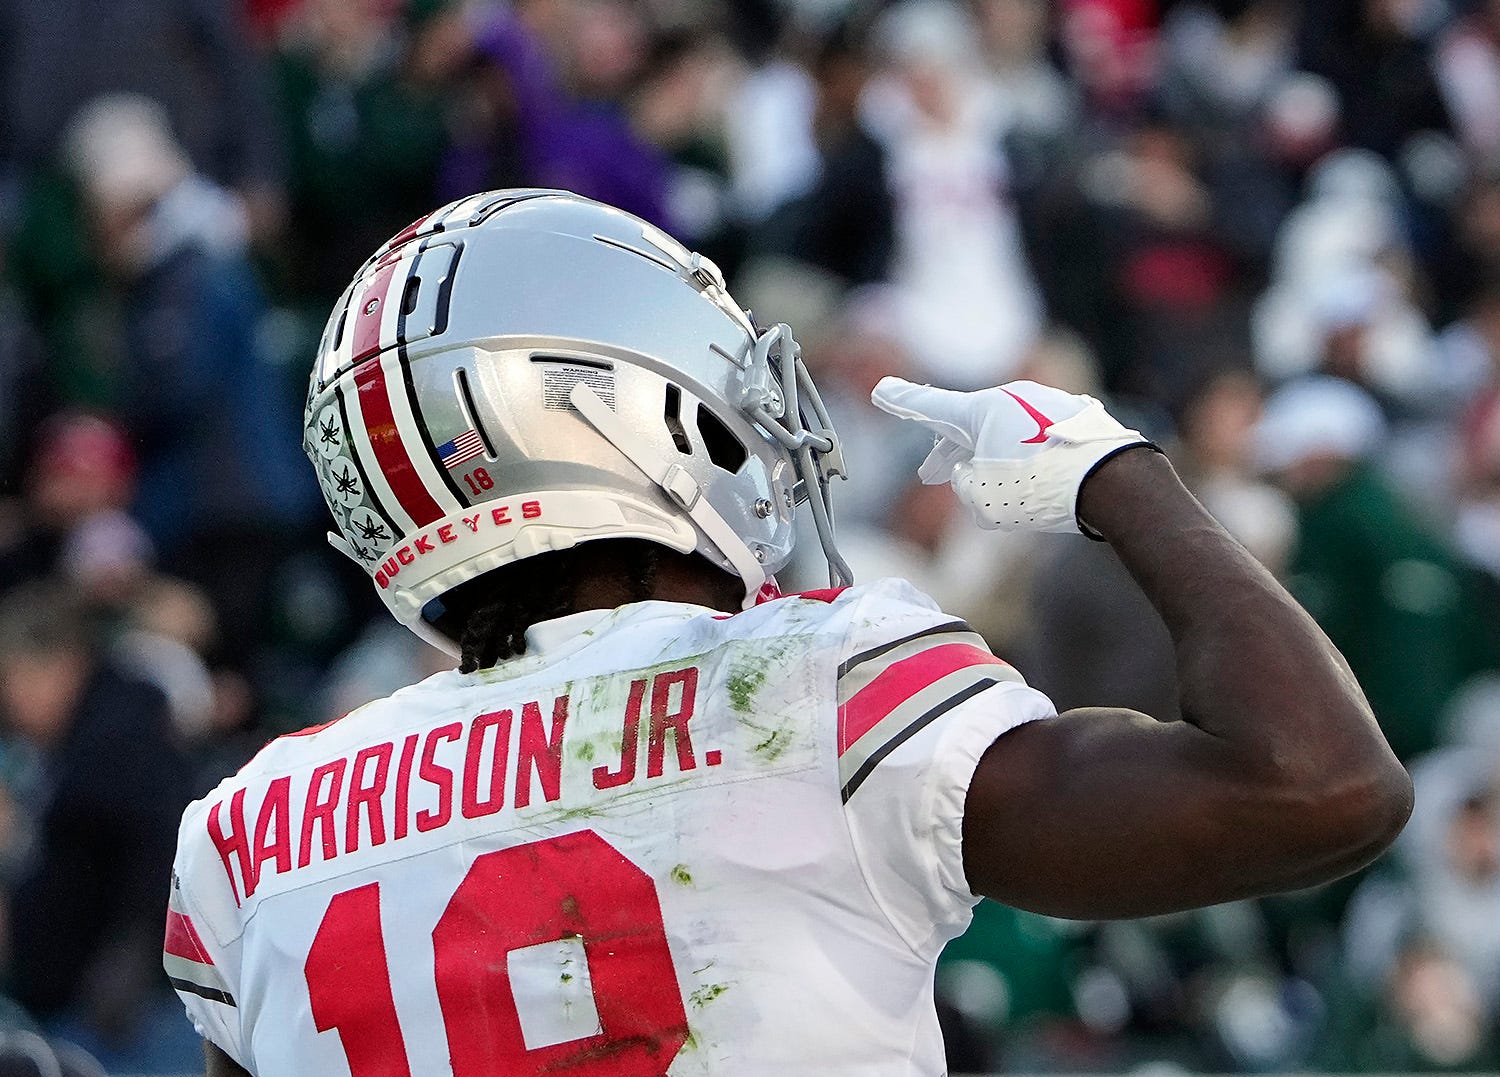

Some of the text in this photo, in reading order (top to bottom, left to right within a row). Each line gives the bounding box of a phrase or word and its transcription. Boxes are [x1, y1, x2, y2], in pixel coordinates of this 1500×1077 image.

[463, 466, 495, 496] 18
[374, 500, 543, 590] BUCKEYES
[207, 666, 723, 908] HARRISON JR.
